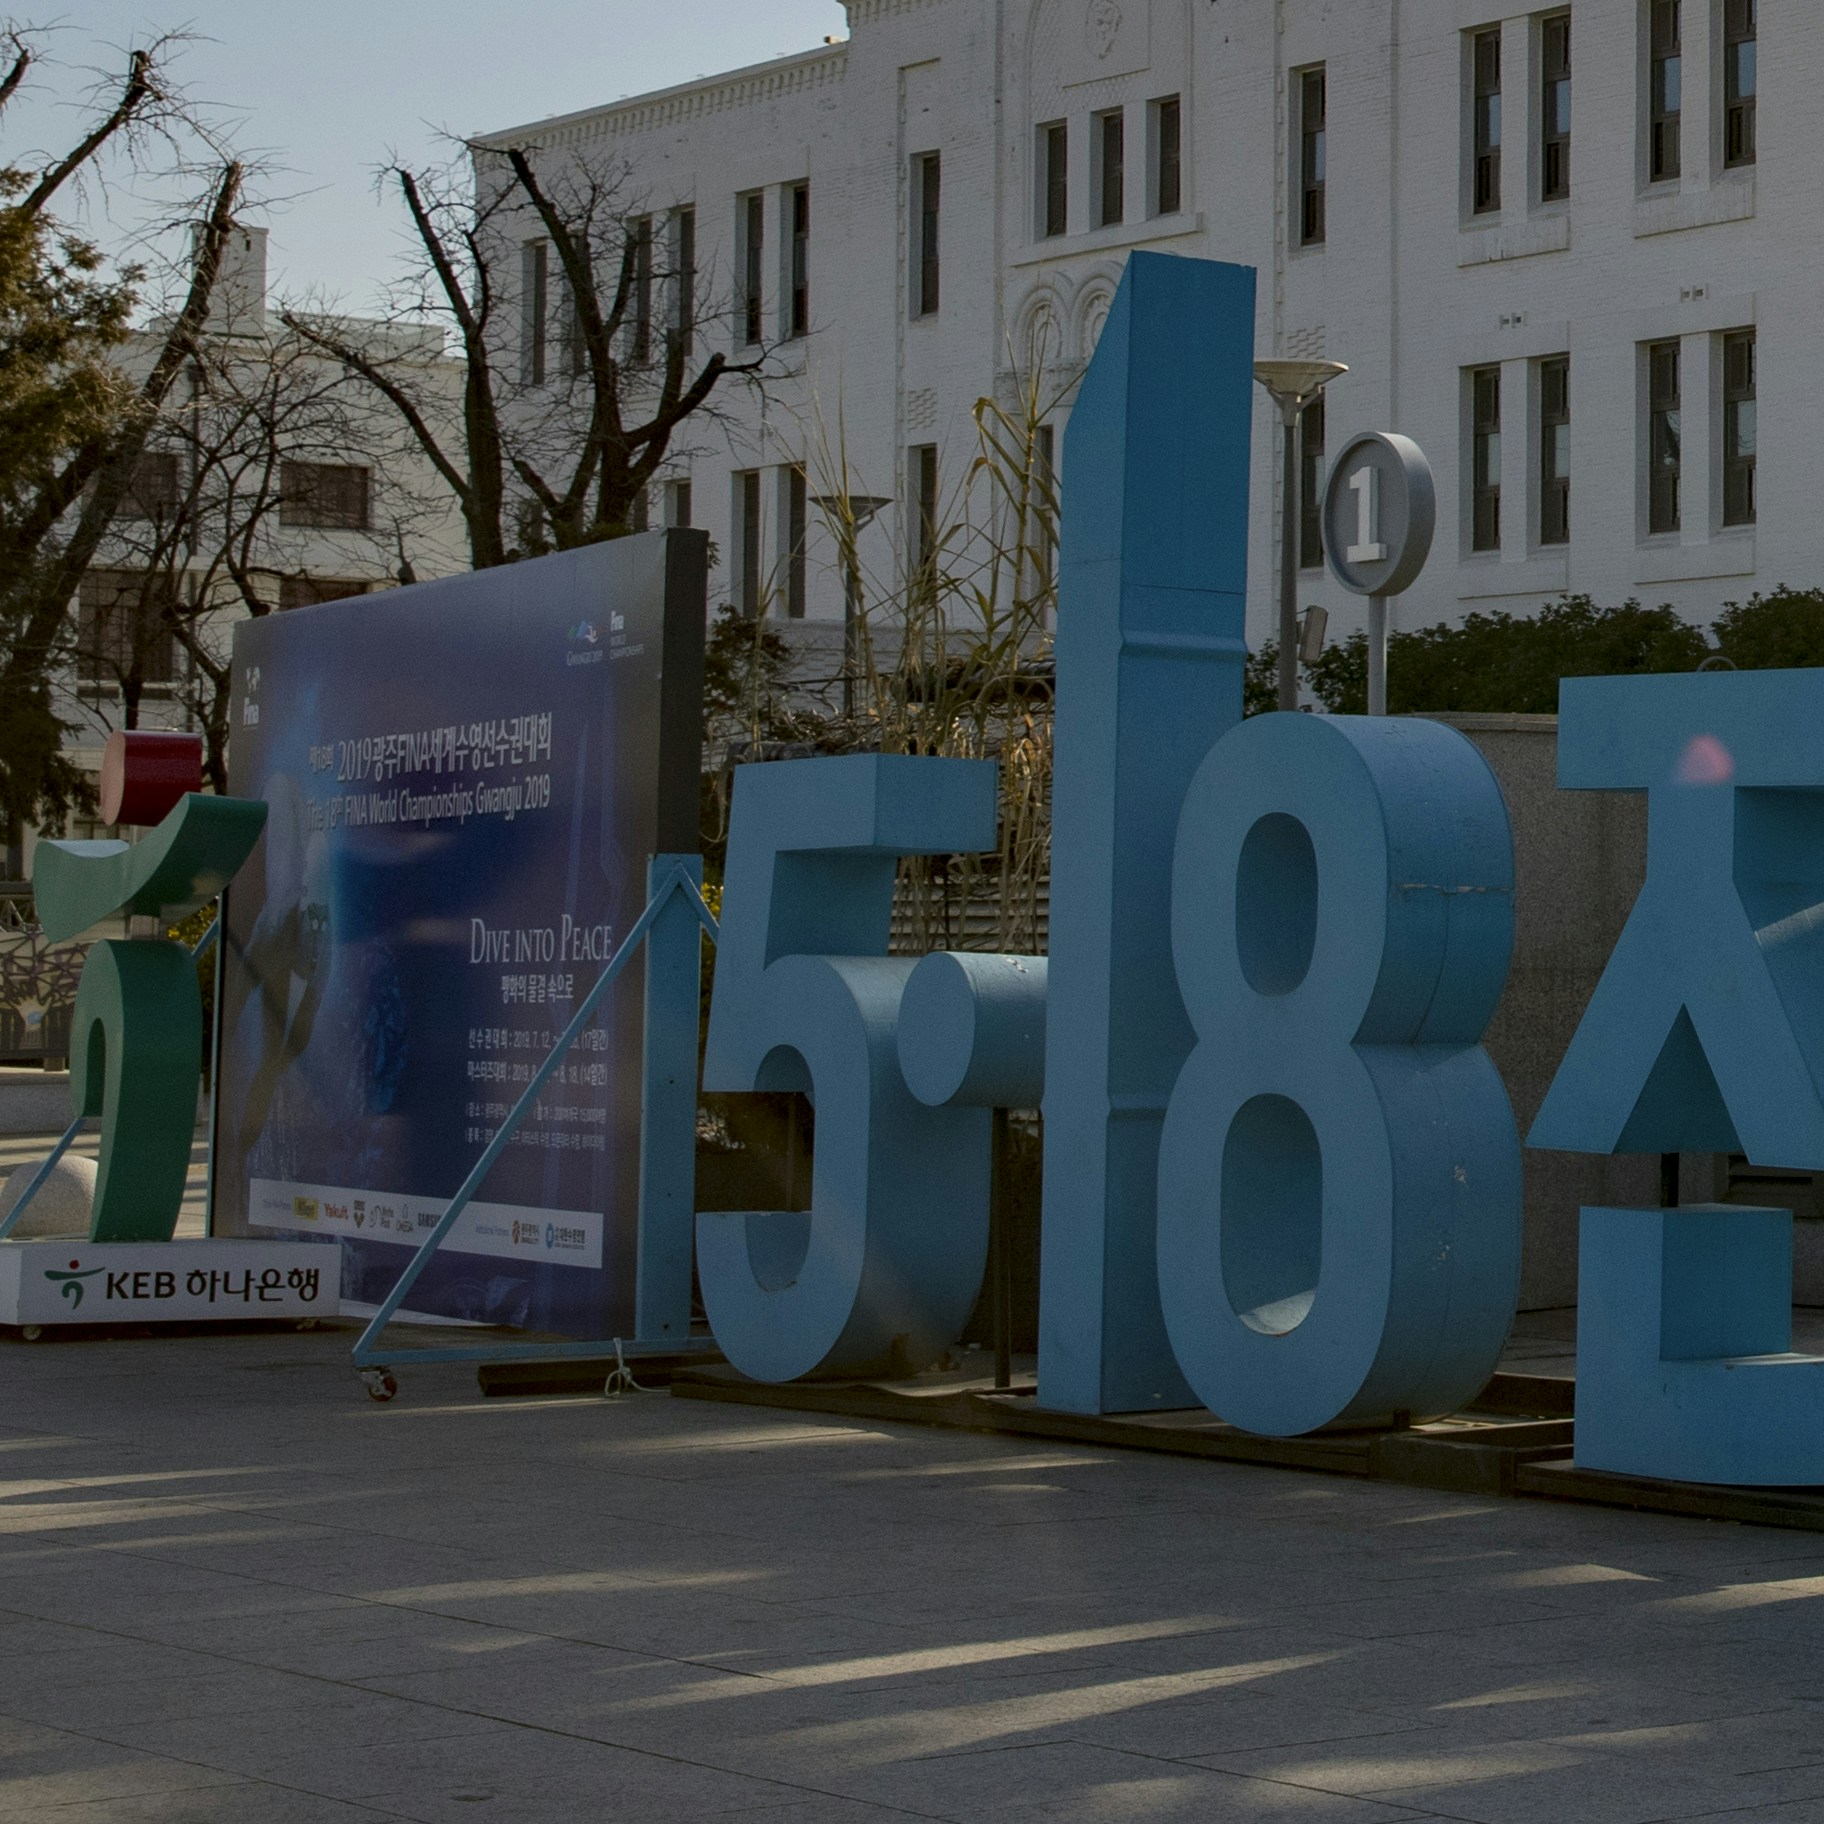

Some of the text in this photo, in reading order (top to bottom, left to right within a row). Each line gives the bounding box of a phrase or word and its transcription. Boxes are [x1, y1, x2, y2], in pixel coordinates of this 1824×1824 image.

[1346, 464, 1388, 564] 1
[344, 793, 368, 827] FINA
[369, 789, 398, 825] World
[399, 783, 474, 829] Championships
[475, 776, 523, 822] Gwangju
[524, 773, 551, 810] 2019
[106, 1266, 320, 1304] KEB 하나은행
